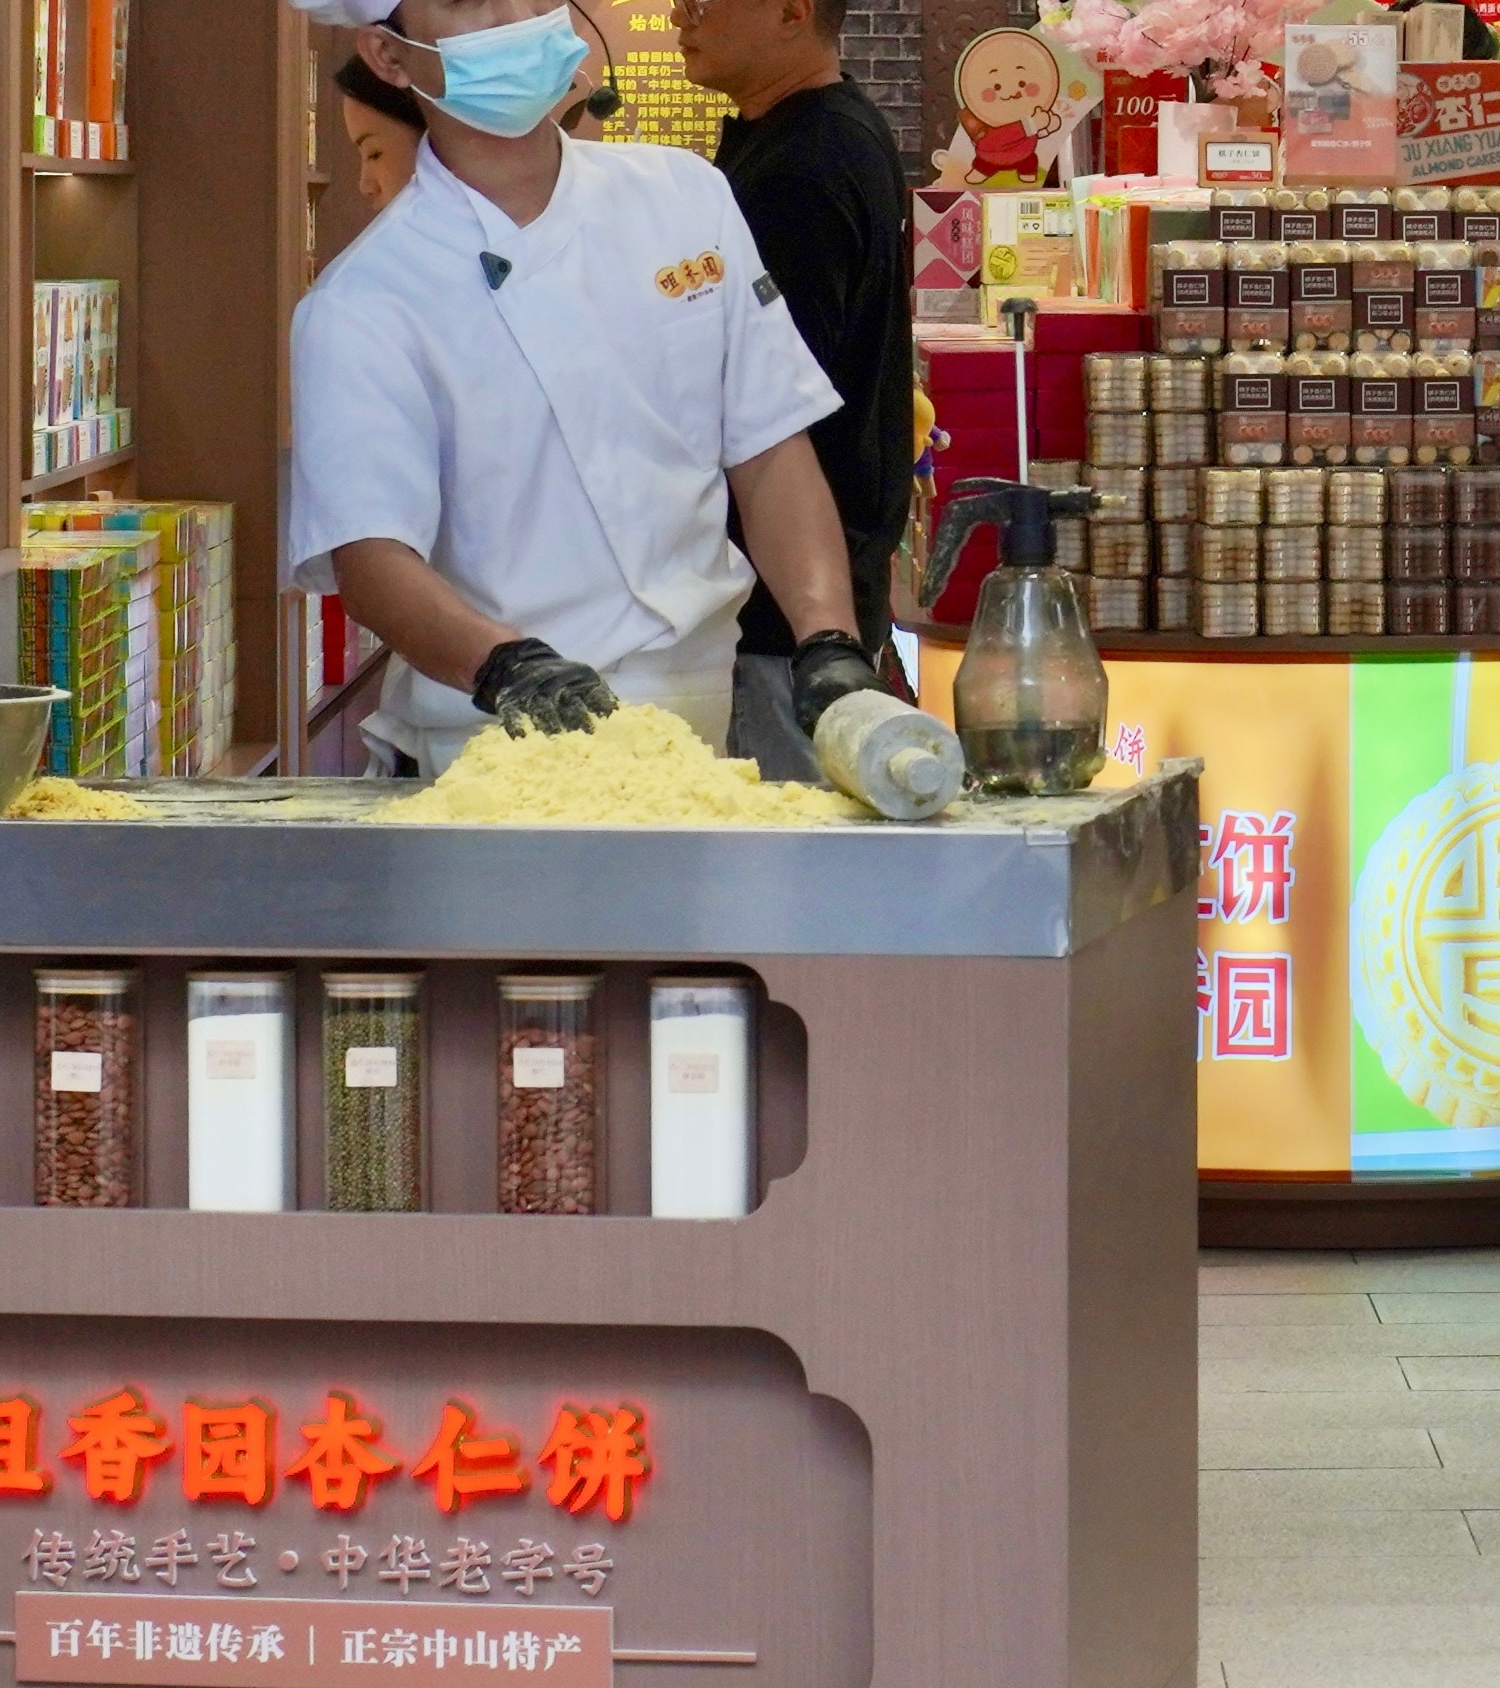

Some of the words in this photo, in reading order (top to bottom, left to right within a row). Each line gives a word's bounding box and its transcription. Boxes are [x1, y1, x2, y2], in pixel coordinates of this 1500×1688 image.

[1113, 96, 1159, 116] 100
[1402, 143, 1422, 162] JU
[1426, 133, 1472, 159] XIANG
[1411, 158, 1464, 178] ALMOND
[1104, 723, 1145, 775] 饼
[1197, 952, 1293, 1061] 园
[45, 1619, 287, 1664] 百年非遗传承
[340, 1627, 583, 1673] 正宗中山特产
